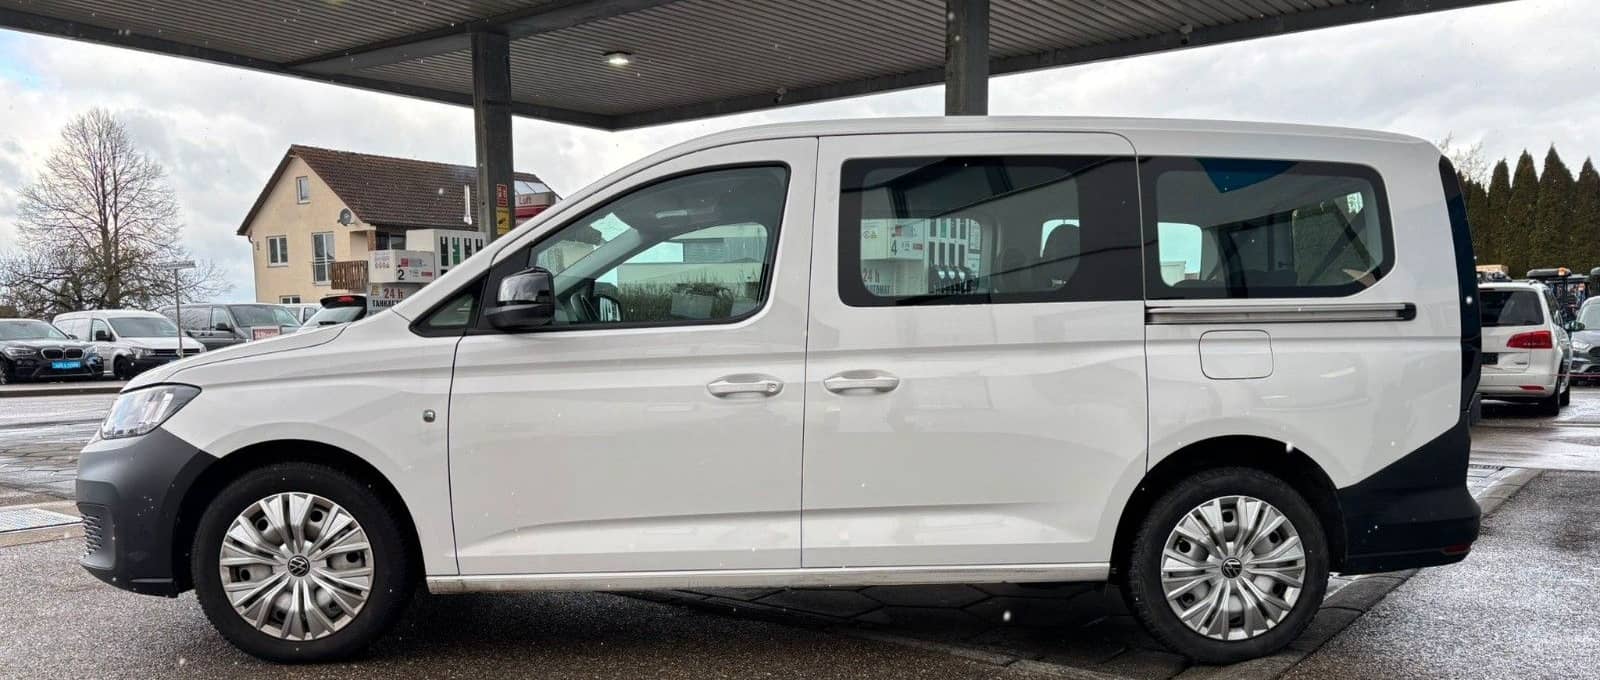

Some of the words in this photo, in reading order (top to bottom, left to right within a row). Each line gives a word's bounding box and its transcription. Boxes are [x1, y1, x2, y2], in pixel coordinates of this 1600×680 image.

[890, 240, 897, 255] 4
[397, 269, 405, 281] 2
[384, 287, 395, 299] 24
